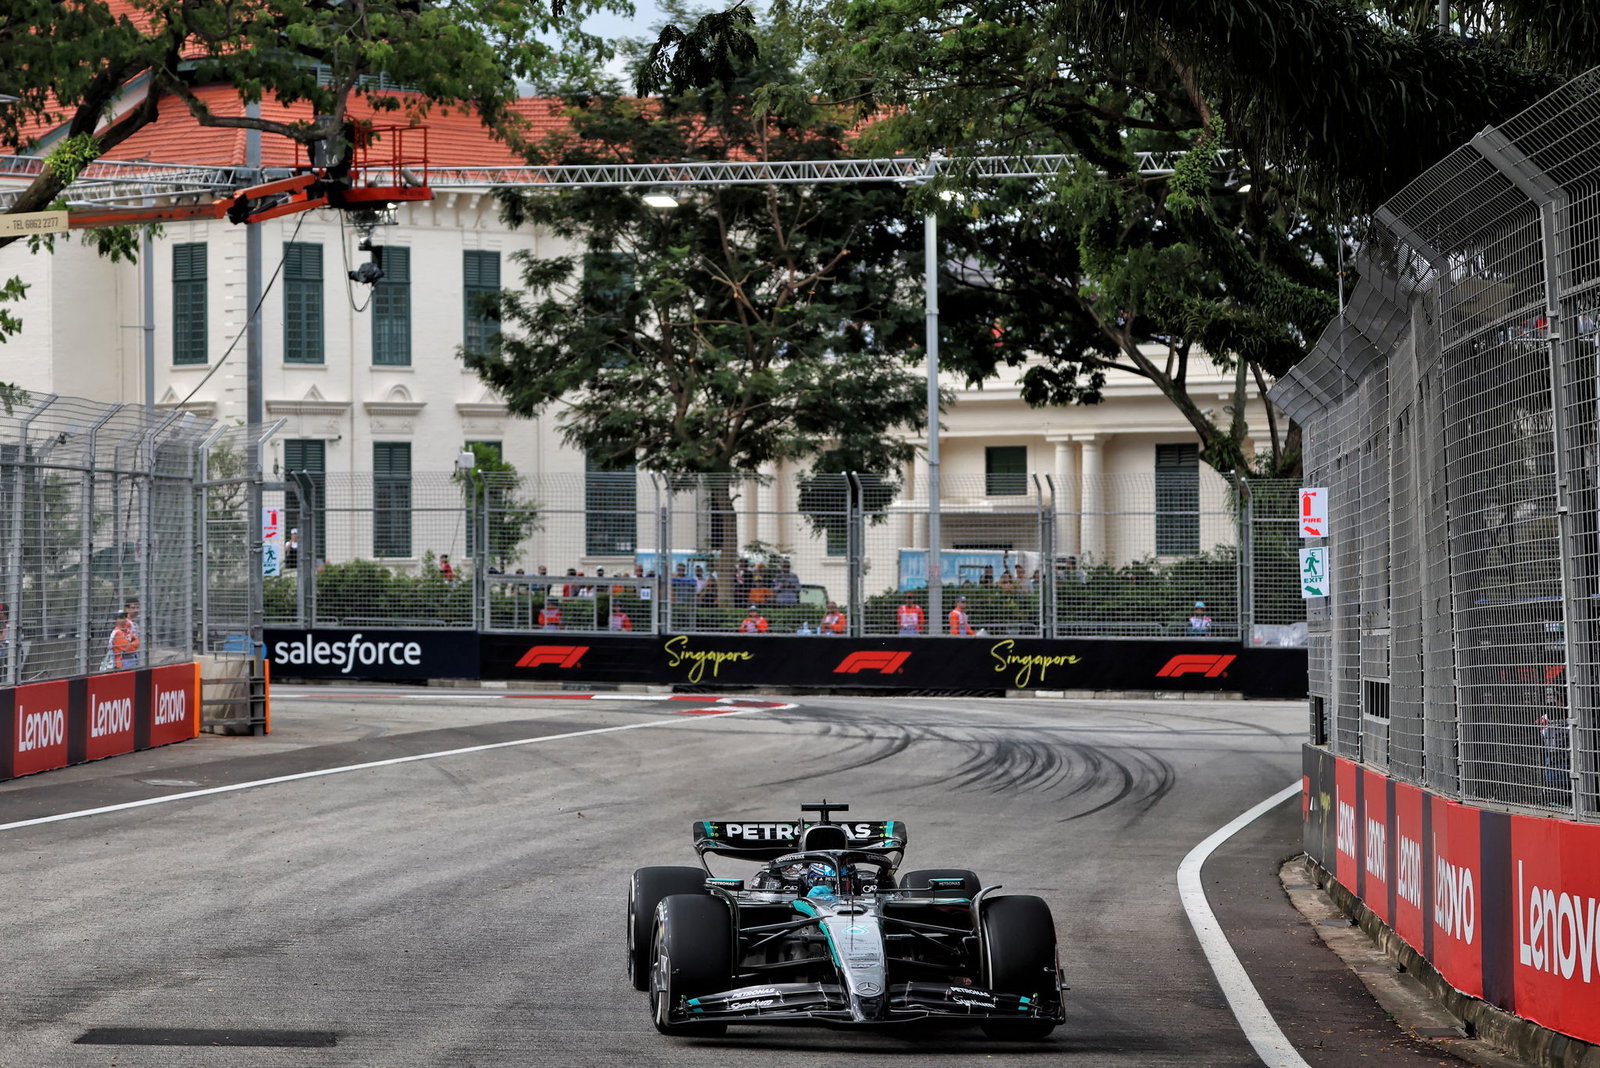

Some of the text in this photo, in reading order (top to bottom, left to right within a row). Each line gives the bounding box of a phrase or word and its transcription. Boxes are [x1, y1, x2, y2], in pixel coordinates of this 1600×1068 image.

[12, 219, 24, 230] TEL
[274, 633, 422, 673] salesforce
[664, 635, 754, 683] Singapore
[991, 639, 1082, 688] Singapore
[91, 693, 132, 738] Lenovo
[155, 683, 186, 726] Lenovo
[18, 705, 64, 752] Lenovo
[1365, 800, 1386, 883] Lenovo
[1397, 815, 1421, 910] Lenovo
[1433, 832, 1475, 945] Lenovo
[1518, 860, 1600, 984] Lenov
[732, 988, 776, 999] PETRONAS
[950, 986, 991, 997] PETRONAS
